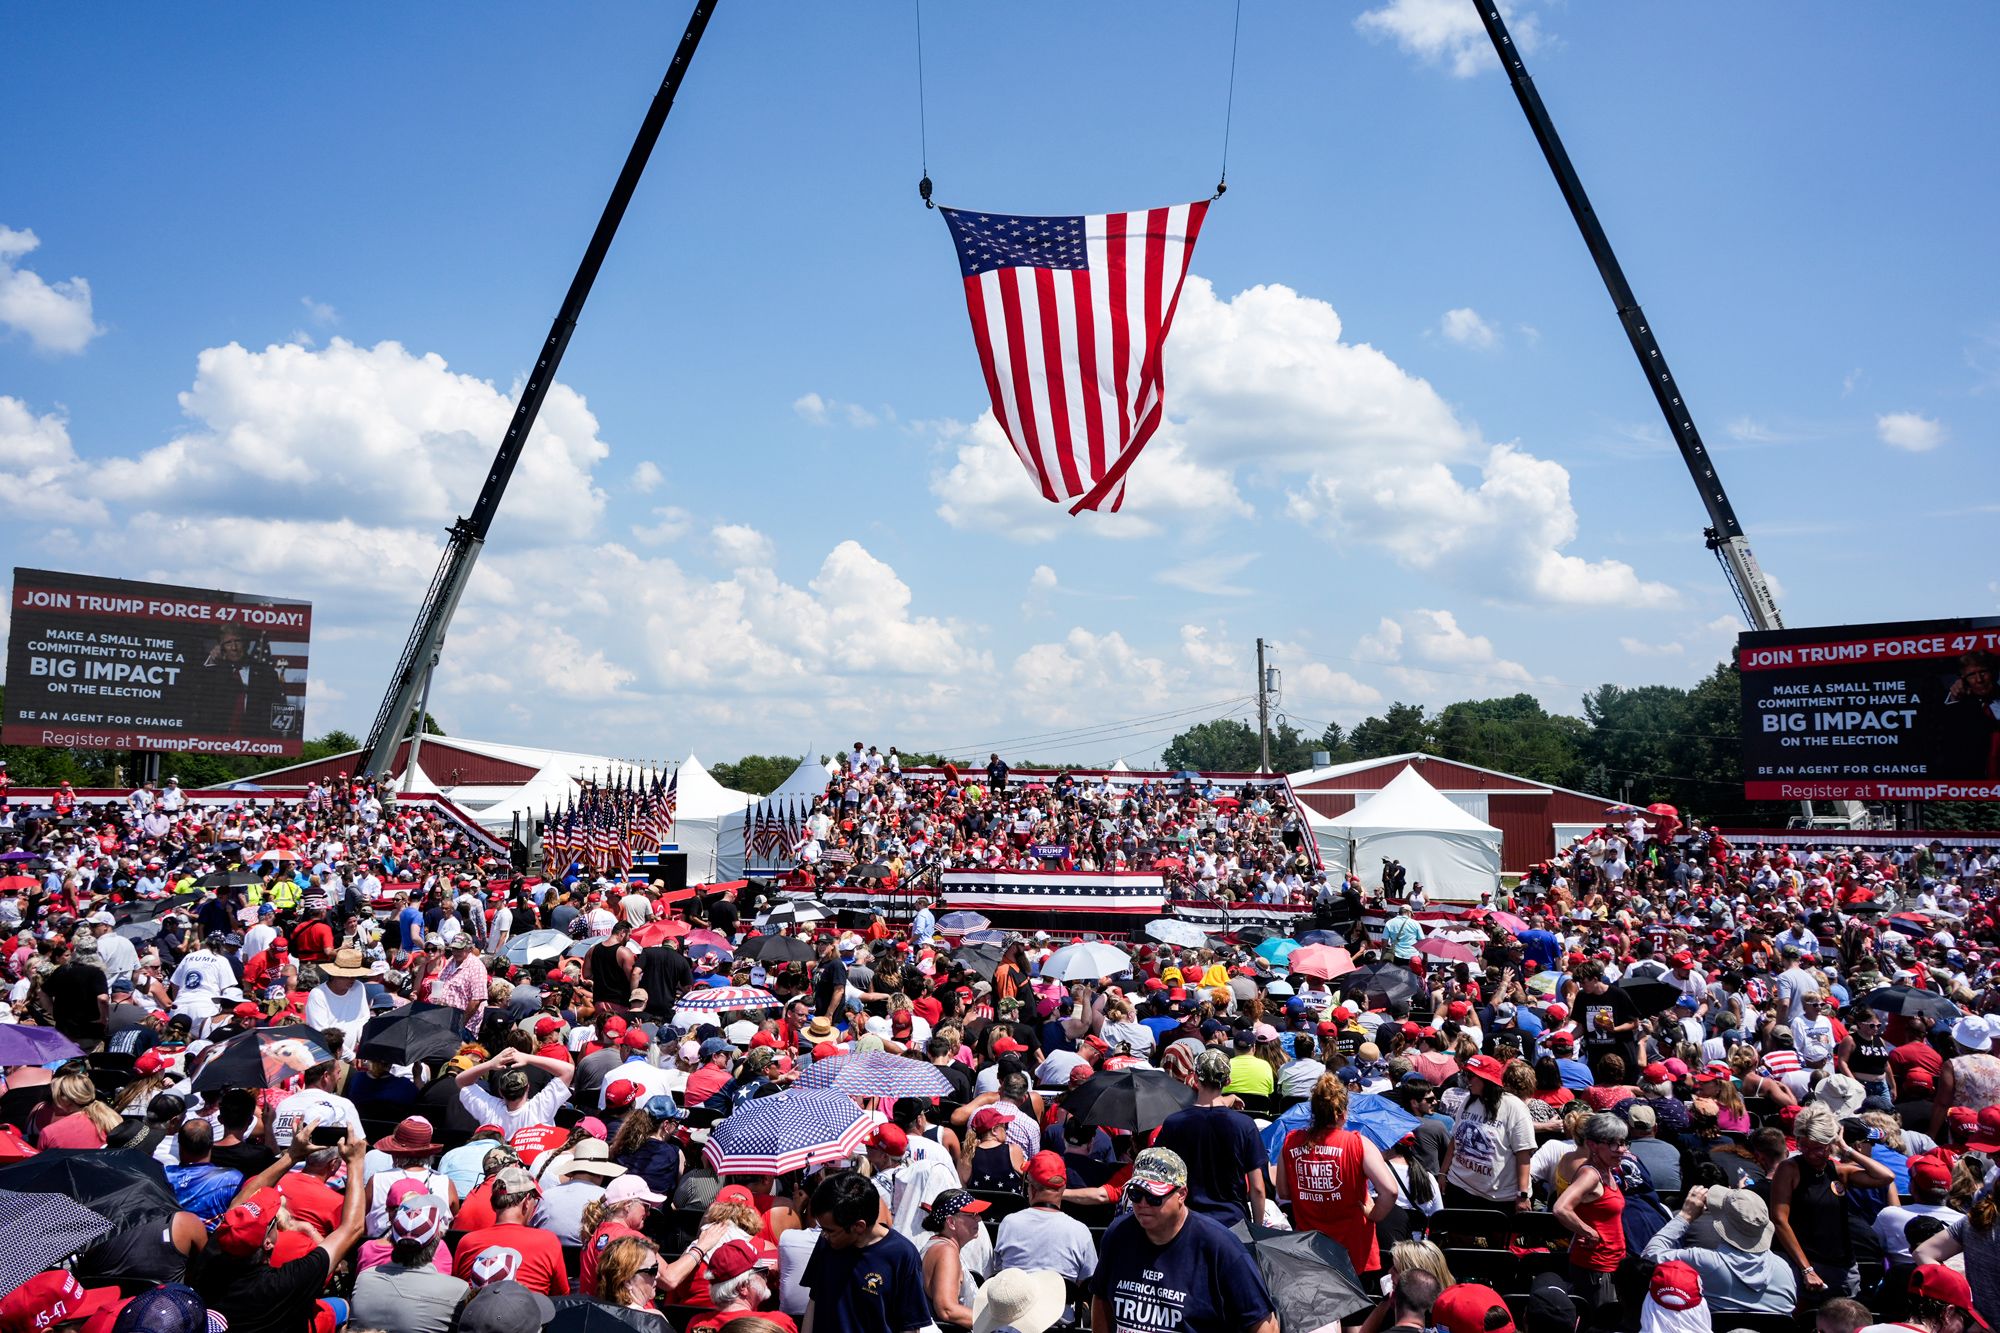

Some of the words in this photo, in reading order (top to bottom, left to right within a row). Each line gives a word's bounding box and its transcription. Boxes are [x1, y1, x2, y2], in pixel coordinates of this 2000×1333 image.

[1738, 548, 1754, 580] NATIONAL
[22, 592, 71, 608] JOIN
[77, 595, 144, 613] TRUMP
[149, 602, 210, 619] FORCE
[215, 607, 237, 621] 47
[241, 609, 303, 626] TODAY!
[46, 629, 84, 641] MAKE
[87, 633, 96, 642] A
[100, 634, 141, 646] SMALL
[145, 638, 174, 649] TIME
[28, 641, 117, 656] COMMITMENT
[120, 648, 136, 658] TO
[140, 650, 172, 661] HAVE
[176, 653, 185, 663] A
[1748, 650, 1793, 666] JOIN
[1798, 644, 1867, 663] TRUMP
[1873, 638, 1945, 656] FORCE
[1951, 636, 1977, 650] 47
[30, 656, 77, 679] BIG
[85, 663, 180, 685] IMPACT
[48, 682, 68, 693] ON
[71, 684, 96, 694] THE
[100, 686, 161, 699] ELECTION
[1773, 685, 1809, 695] MAKE
[1813, 684, 1822, 693] A
[1826, 682, 1870, 692] SMALL
[1873, 681, 1906, 691] TIME
[1758, 697, 1843, 708] COMMITMENT
[1848, 696, 1866, 705] TO
[1870, 694, 1906, 704] HAVE
[1910, 694, 1920, 704] A
[20, 710, 35, 719] BE
[40, 711, 58, 720] AN
[62, 713, 103, 723] AGENT
[107, 716, 131, 724] FOR
[136, 717, 183, 727] CHANGE
[272, 715, 293, 729] 47
[1762, 714, 1806, 733] BIG
[1815, 710, 1917, 731] IMPACT
[42, 731, 111, 748] Register
[115, 734, 131, 747] at
[137, 735, 283, 754] TrumpForce47.com
[1781, 738, 1799, 747] ON
[1803, 737, 1829, 746] THE
[1832, 735, 1898, 745] ELECTION
[1799, 766, 1839, 774] AGENT
[1873, 765, 1927, 773] CHANGE
[1782, 785, 1848, 800] Register
[1855, 786, 1871, 797] at
[1654, 936, 1663, 951] 2
[278, 1118, 293, 1126] TRU
[1461, 1111, 1470, 1120] GET
[1136, 1157, 1168, 1175] TRUMP
[1304, 1164, 1307, 1175] I
[1310, 1164, 1332, 1176] WAS
[1306, 1177, 1334, 1189] THERE
[1300, 1192, 1324, 1202] BUTLER
[1331, 1192, 1341, 1201] PA
[1142, 1269, 1164, 1281] KEEP
[1117, 1280, 1155, 1296] AMERICA
[1157, 1288, 1186, 1302] GREAT
[1675, 1288, 1690, 1299] TRUMP
[1114, 1297, 1182, 1328] TRUMP
